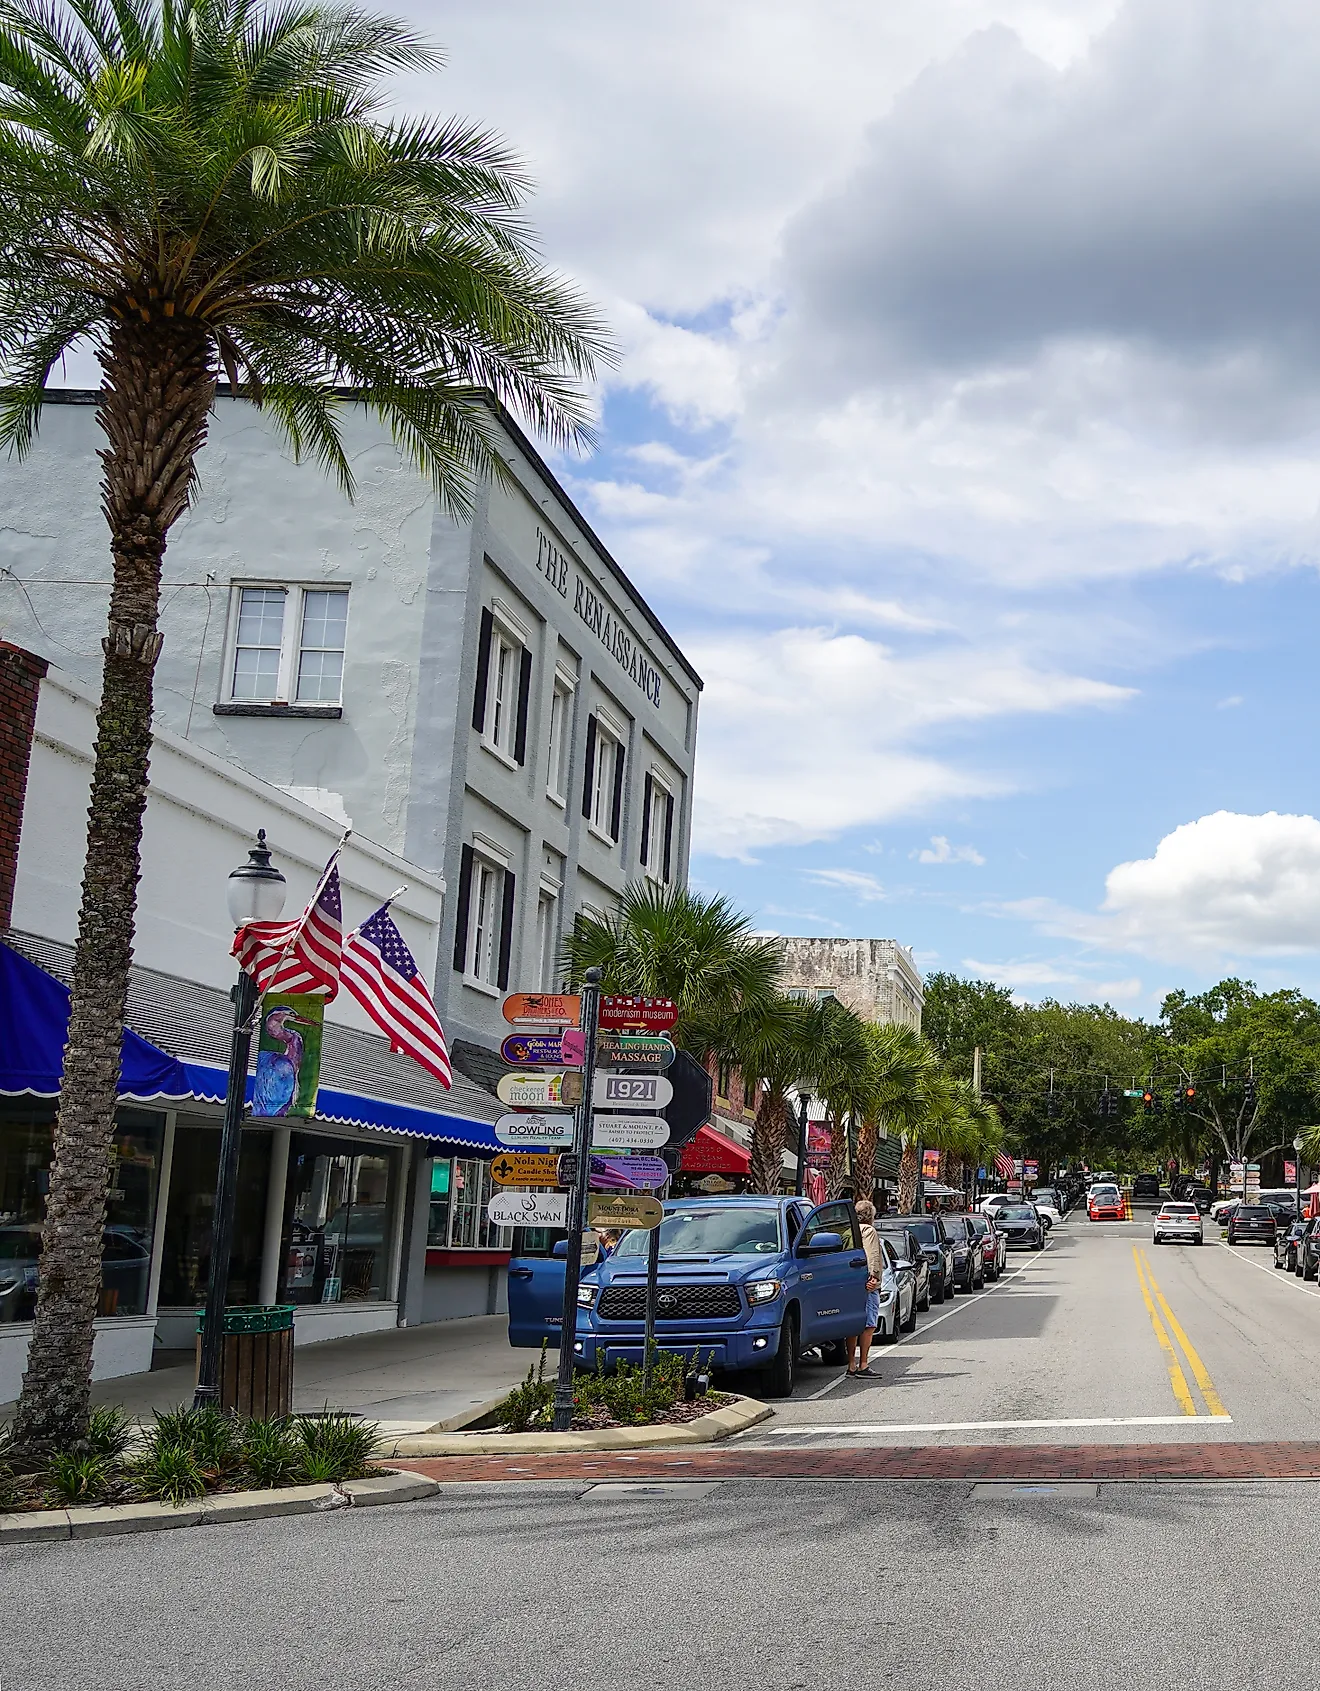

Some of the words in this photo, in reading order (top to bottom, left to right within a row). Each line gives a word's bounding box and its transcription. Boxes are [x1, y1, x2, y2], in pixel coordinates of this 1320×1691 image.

[536, 526, 569, 599] THE
[573, 574, 661, 709] RENAISSANCE
[603, 1008, 640, 1018] modernism
[642, 1010, 674, 1019] museum
[603, 1042, 640, 1050] HEALING
[641, 1043, 671, 1051] HANDS
[611, 1052, 662, 1062] MASSAGE
[609, 1080, 653, 1099] 1921
[509, 1091, 545, 1101] moon
[509, 1125, 565, 1135] DOWLING
[514, 1157, 535, 1165] Nola
[493, 1211, 530, 1222] BLACK
[532, 1211, 562, 1222] SWAN
[816, 1308, 841, 1316] TUNDRA
